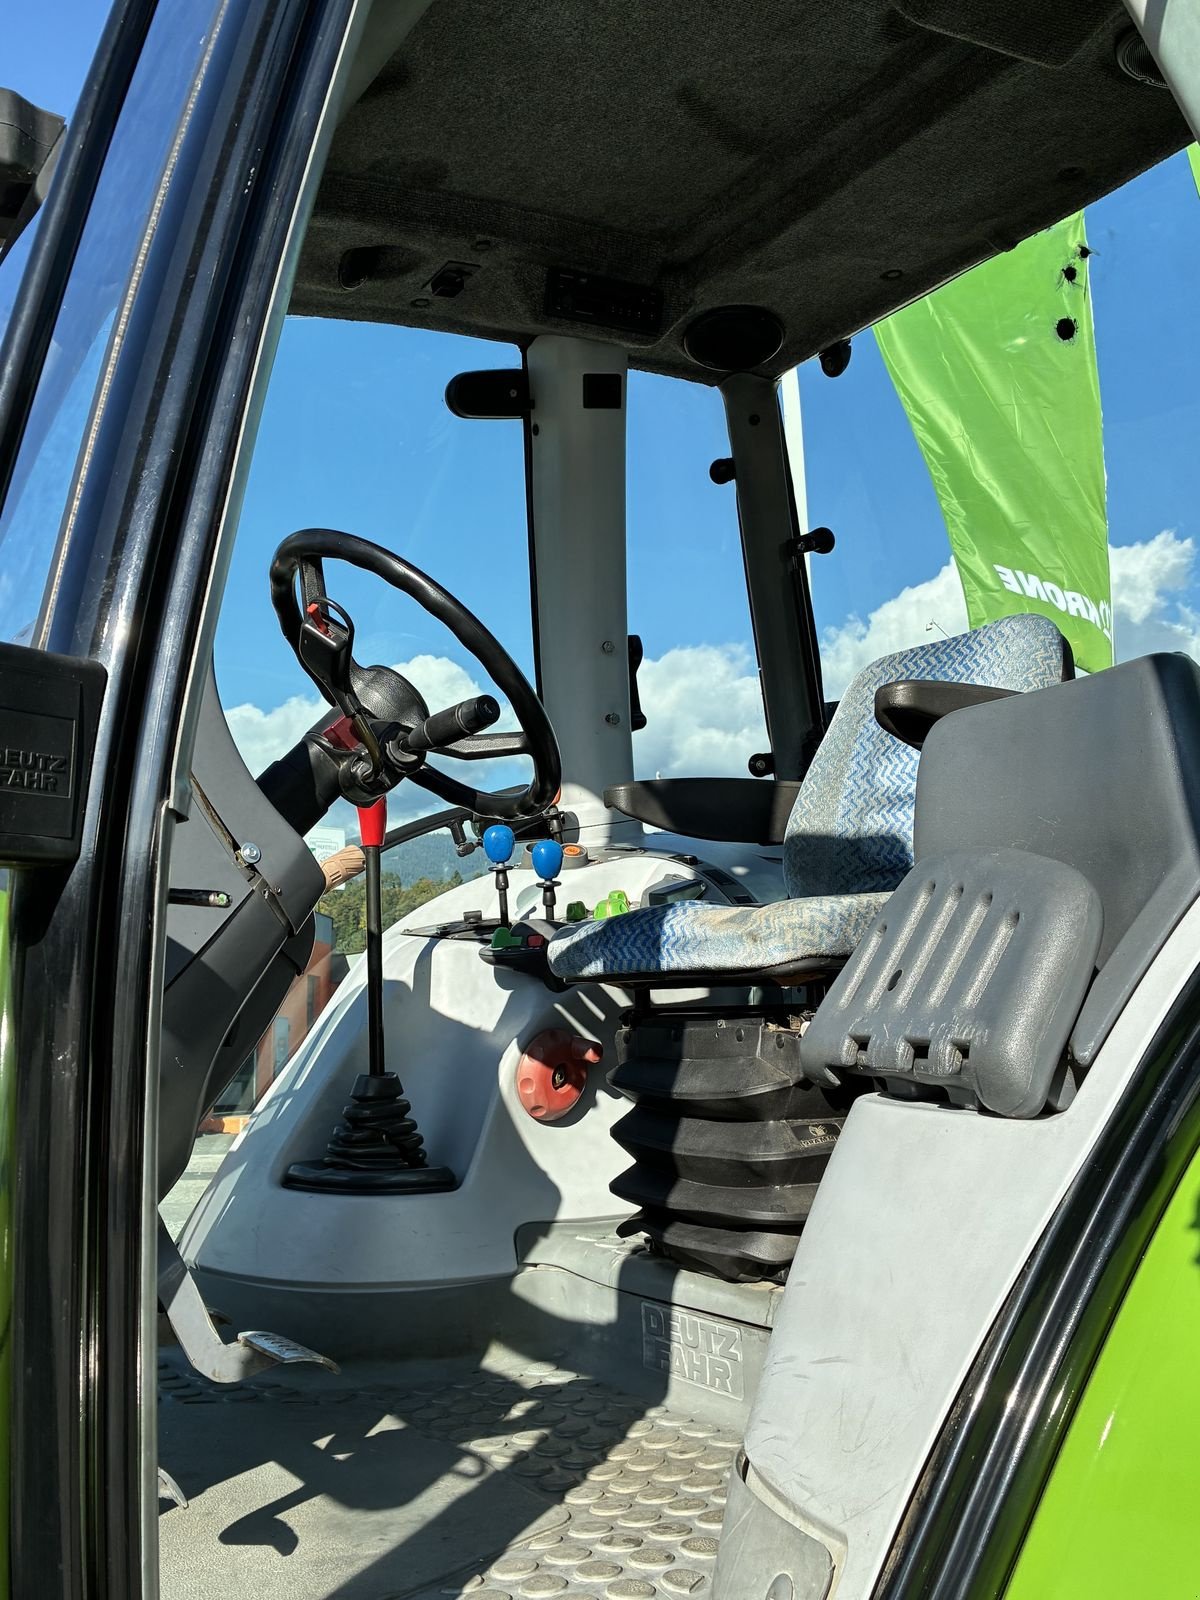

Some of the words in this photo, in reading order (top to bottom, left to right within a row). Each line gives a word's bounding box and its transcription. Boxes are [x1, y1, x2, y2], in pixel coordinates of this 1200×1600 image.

[0, 748, 66, 773] EUTZ
[643, 1303, 741, 1362] DEUTZ
[655, 1338, 732, 1393] FAHR
